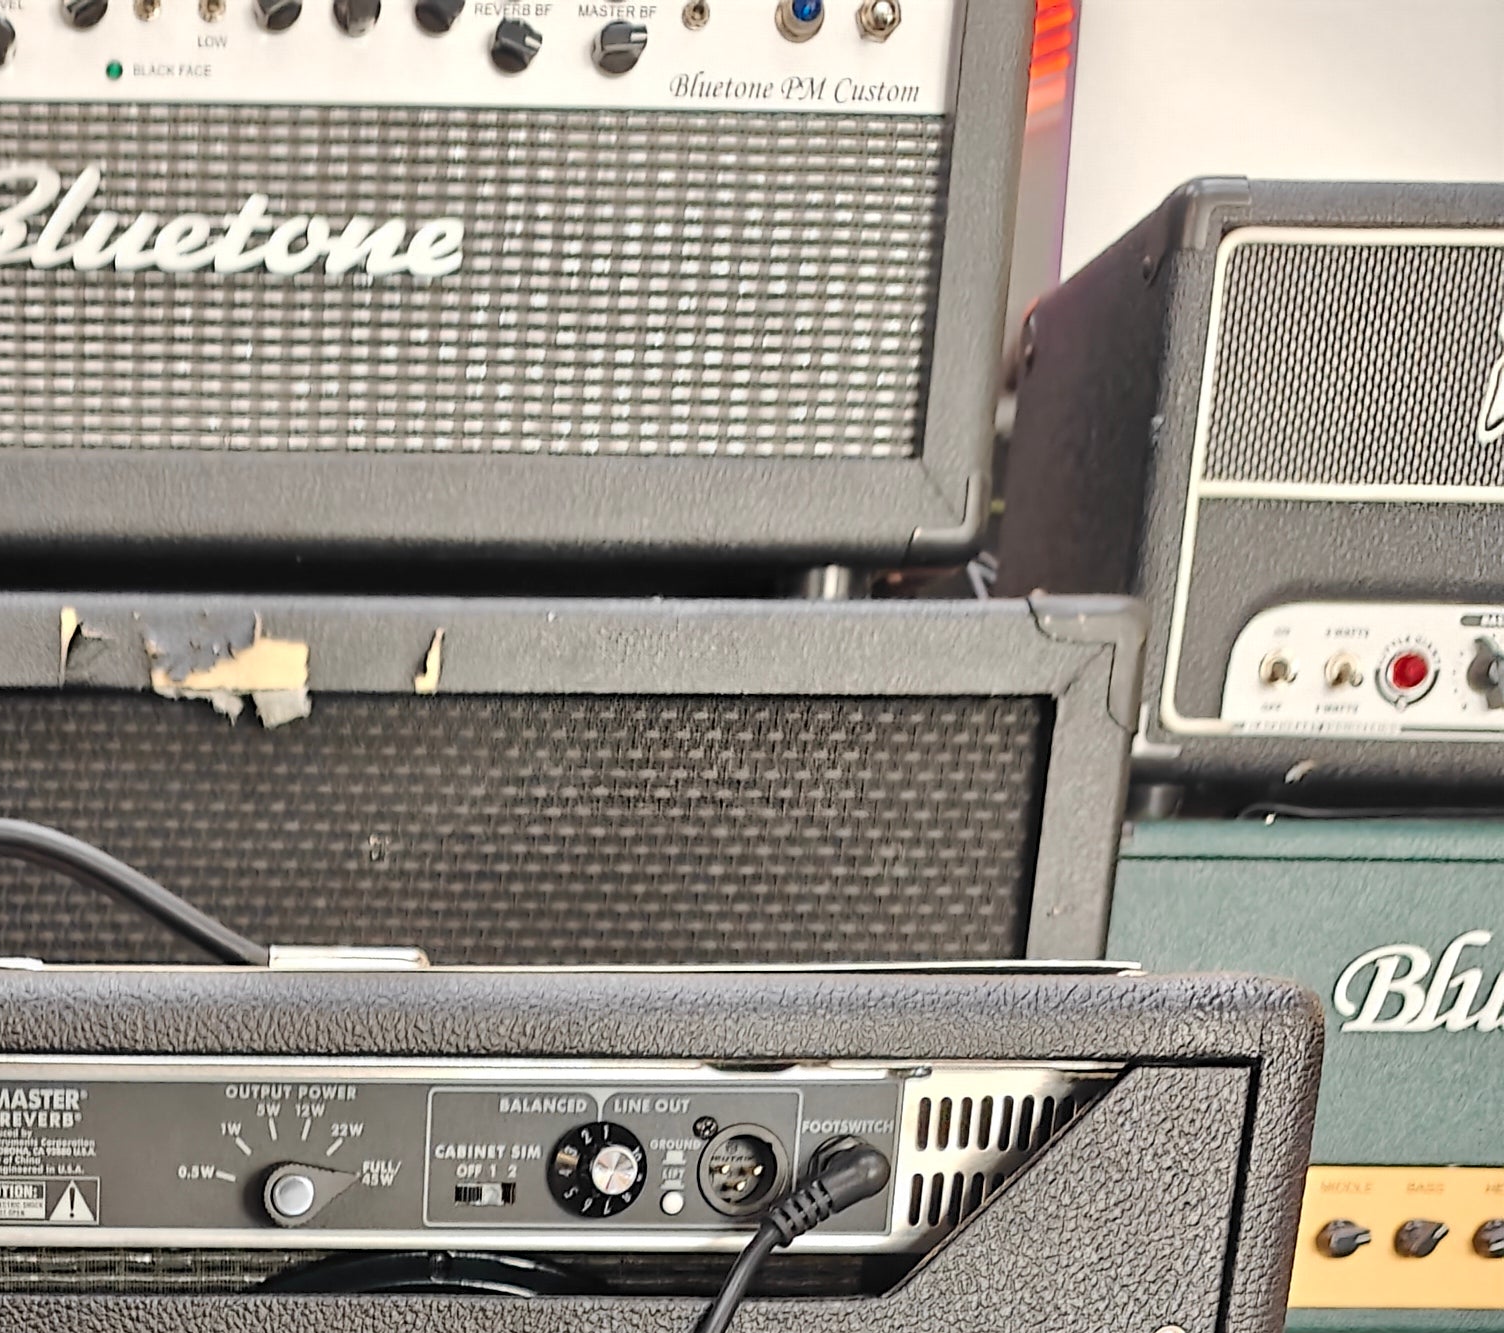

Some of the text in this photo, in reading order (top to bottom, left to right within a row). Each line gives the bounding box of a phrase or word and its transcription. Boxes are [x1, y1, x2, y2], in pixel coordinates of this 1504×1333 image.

[474, 4, 552, 17] REVERB BF
[579, 5, 657, 18] MASTER BF
[197, 36, 227, 48] LOW
[133, 65, 212, 76] BLACK FACE
[670, 72, 920, 102] Bluetone PM Custom
[225, 1085, 357, 1100] OUTPUT POWER
[257, 1104, 281, 1116] 5W
[296, 1104, 325, 1117] 12W
[499, 1098, 587, 1113] BALANCED
[614, 1099, 691, 1113] LINE OUT
[221, 1123, 241, 1135] 1W
[331, 1123, 364, 1136] 22W
[802, 1119, 894, 1134] FOOTSWITCH
[650, 1139, 701, 1150] GROUND
[435, 1145, 541, 1159] CABINET SIM
[178, 1165, 216, 1179] 0.5W
[457, 1164, 517, 1178] OFF 1 2
[662, 1168, 684, 1179] LIFT
[362, 1174, 395, 1186] 45W
